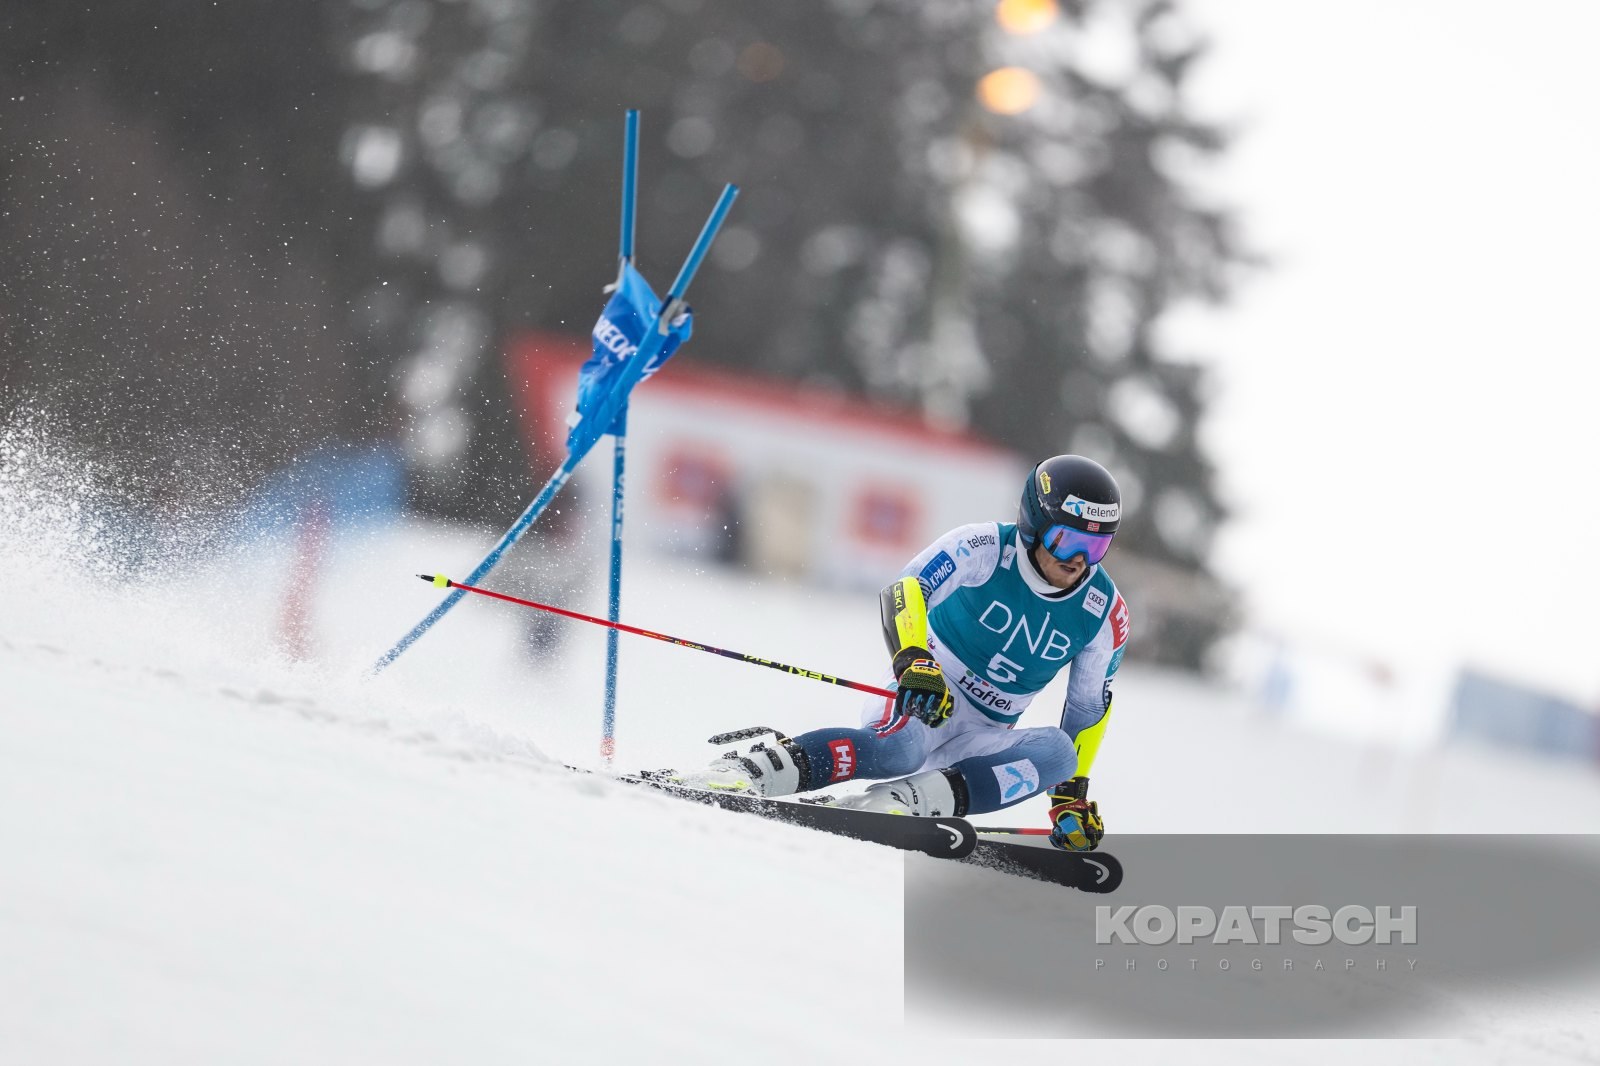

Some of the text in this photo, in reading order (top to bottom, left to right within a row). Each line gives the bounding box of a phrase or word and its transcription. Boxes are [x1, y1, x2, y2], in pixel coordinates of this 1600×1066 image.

[929, 560, 953, 588] KPMG
[893, 583, 903, 609] LEKI
[979, 600, 1072, 661] DNB
[788, 666, 837, 685] LEKI
[986, 652, 1025, 683] 5
[834, 744, 853, 778] HH
